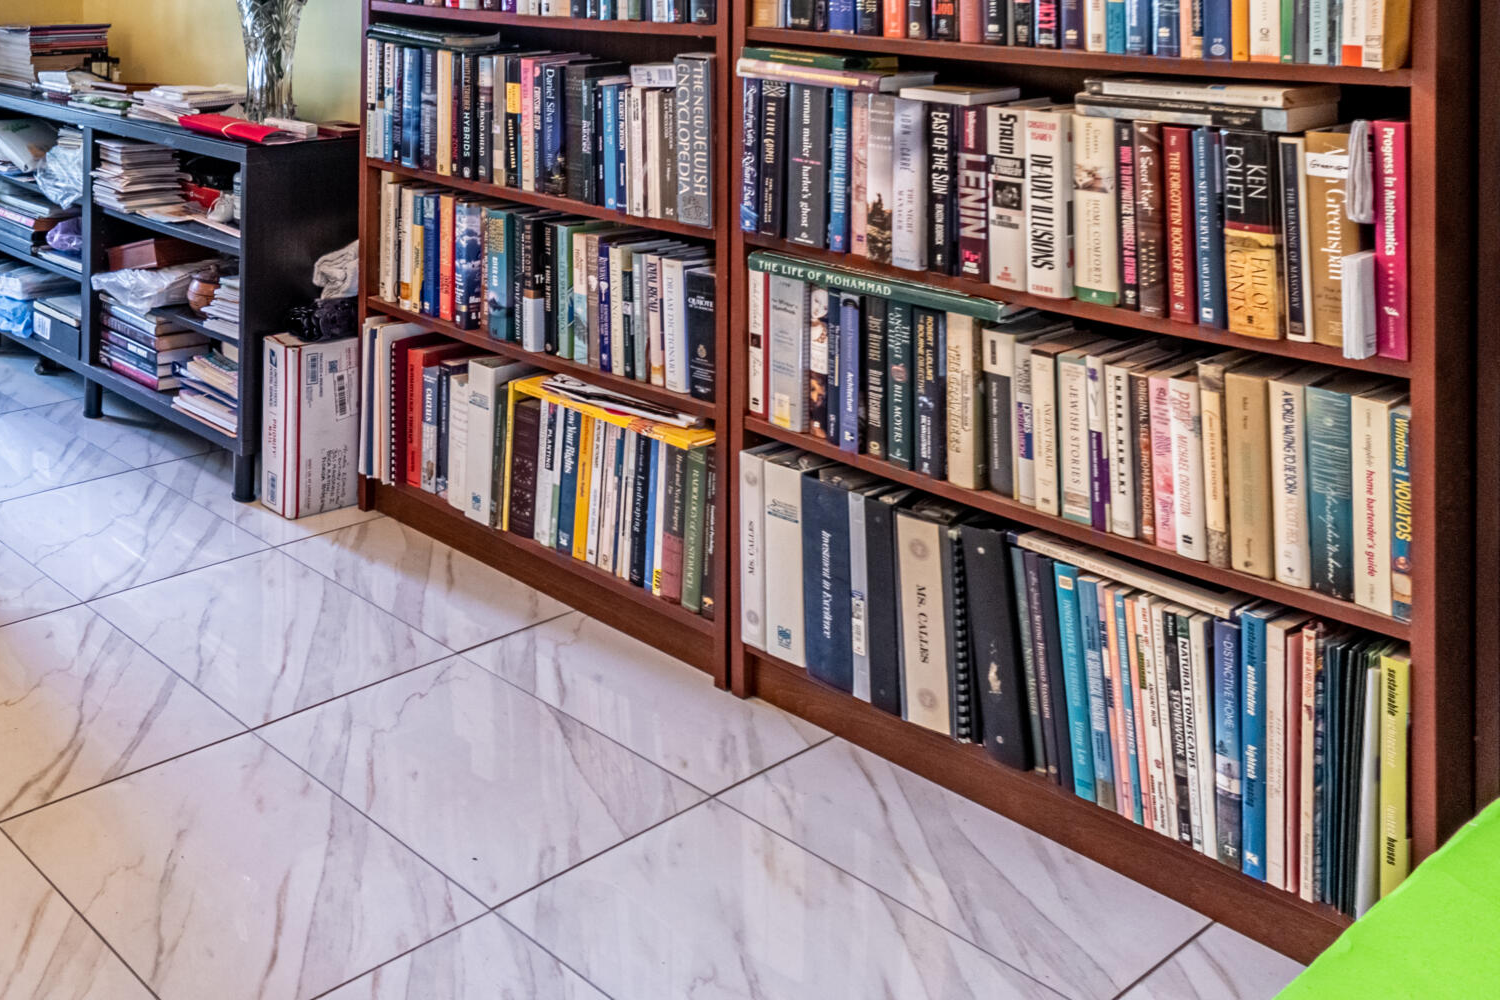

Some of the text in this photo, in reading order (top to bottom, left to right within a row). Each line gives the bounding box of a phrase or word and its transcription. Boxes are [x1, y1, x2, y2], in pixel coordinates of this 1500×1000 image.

[544, 68, 556, 124] Daniel Silva
[676, 63, 691, 196] ENCYCLOPEDIA
[692, 62, 709, 197] THE NEW JEWISH
[801, 88, 814, 158] norman mailer
[931, 111, 951, 195] EAST OF THE SUN
[1139, 156, 1154, 187] Secret
[1224, 145, 1245, 214] FOLLETT
[1246, 163, 1268, 200] KEN
[799, 164, 814, 228] harlot's ghost
[957, 152, 987, 240] LENIN
[1030, 153, 1055, 271] DEADLY ILLUSIONS
[1120, 145, 1137, 284] HOW TO HYPNOTIZE YOURSELF OTHERS
[1169, 151, 1186, 297] THE FORGOTTEN BOOKS OF EDEN
[1198, 180, 1210, 251] SECRET SERVICE
[1380, 126, 1399, 257] Progress in Mathematics
[1091, 199, 1103, 285] HOME COMFORTS
[1286, 207, 1297, 249] MEANING
[1320, 188, 1346, 281] Greenspan
[646, 262, 660, 313] TOTAL RECALL
[757, 260, 893, 297] THE LIFE OF MOHAMMAD
[1228, 249, 1246, 313] GIANTS
[1250, 256, 1271, 312] FALL OF
[925, 315, 935, 347] ROBERT
[845, 371, 855, 413] Architecture
[893, 306, 904, 443] LANGUAGE BILL MOYERS
[1138, 379, 1149, 421] ORIGINAL
[564, 426, 577, 444] Your
[1068, 385, 1082, 485] JEWISH STORIES
[1281, 397, 1294, 424] WORLD
[1282, 424, 1295, 453] WAITING
[562, 444, 576, 474] Rights
[1176, 434, 1190, 472] MICHAEL
[1393, 416, 1412, 543] Windows NOVATOS
[632, 474, 646, 533] Landscaping
[689, 468, 700, 520] RADIOLOGY
[1179, 473, 1192, 518] CRICHTON
[1364, 469, 1378, 577] home bartender's guide
[820, 529, 833, 639] Investment in Excellence
[915, 584, 930, 664] MS. CALLES
[1062, 599, 1088, 766] INNOVATIVE INTERIORS Vinny Lee
[1178, 639, 1197, 770] NATURAL STONESCAPES
[1222, 640, 1236, 728] DISTINCTIVE HOME
[1124, 708, 1137, 756] PHONICS
[1171, 689, 1186, 757] STONEWORK
